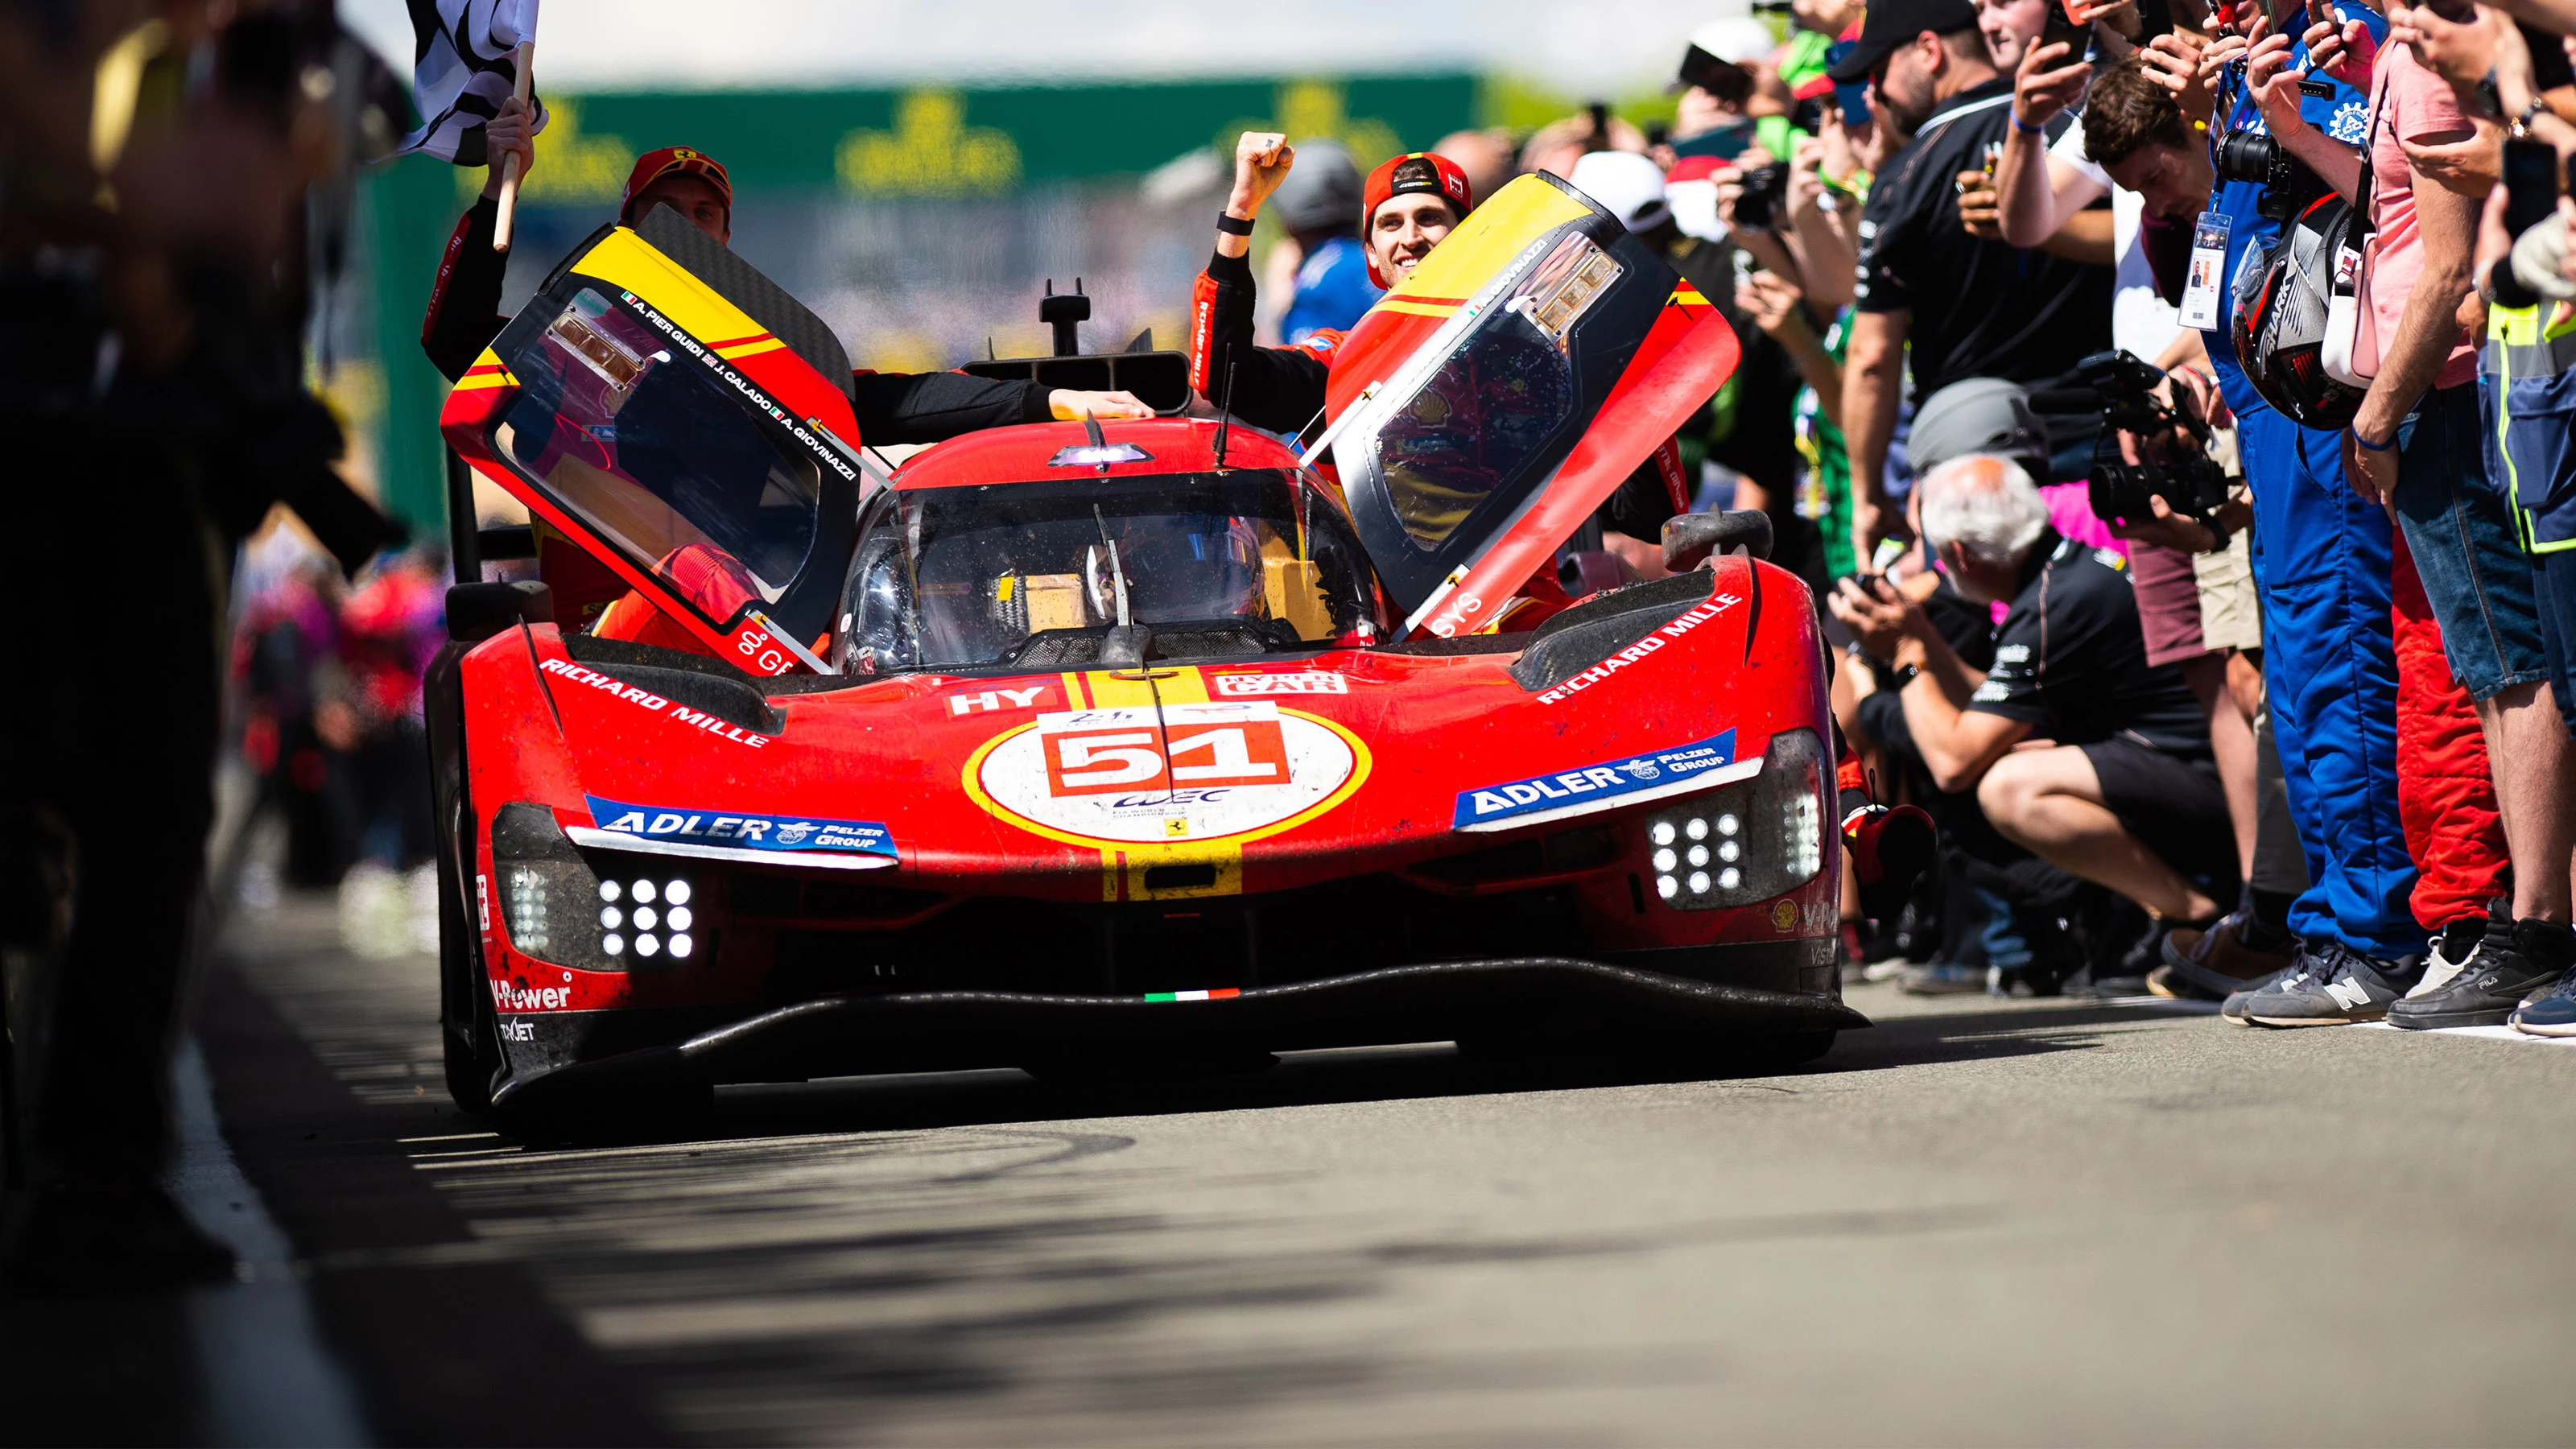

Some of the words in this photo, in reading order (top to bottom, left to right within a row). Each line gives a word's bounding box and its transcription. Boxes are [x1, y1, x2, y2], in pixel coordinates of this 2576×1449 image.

[1489, 238, 1548, 296] GIOVINAZZI
[2266, 277, 2291, 357] SHARK
[633, 302, 646, 315] A.
[646, 309, 674, 334] PIER
[671, 330, 705, 357] GUIDI
[714, 364, 724, 376] J.
[724, 371, 772, 411] CALADO
[781, 418, 793, 431] A.
[794, 427, 857, 481] GIOVINAZZI
[1537, 637, 1666, 704] RICHARD
[1662, 592, 1742, 637] MILLE
[1224, 675, 1335, 683] HYPER
[1228, 681, 1338, 691] CAR
[539, 658, 668, 711] RICHARD
[671, 707, 769, 748] MILLE
[950, 687, 1045, 715] HY
[1058, 728, 1278, 788] 51
[1656, 747, 1716, 764] PELZER
[1668, 755, 1725, 773] GROUP
[1113, 790, 1231, 807] WEC
[1471, 767, 1626, 815] ADLER
[601, 811, 772, 840] ADLER
[822, 825, 885, 837] PELZER
[815, 835, 877, 848] GROUP
[2478, 976, 2499, 990] FILA
